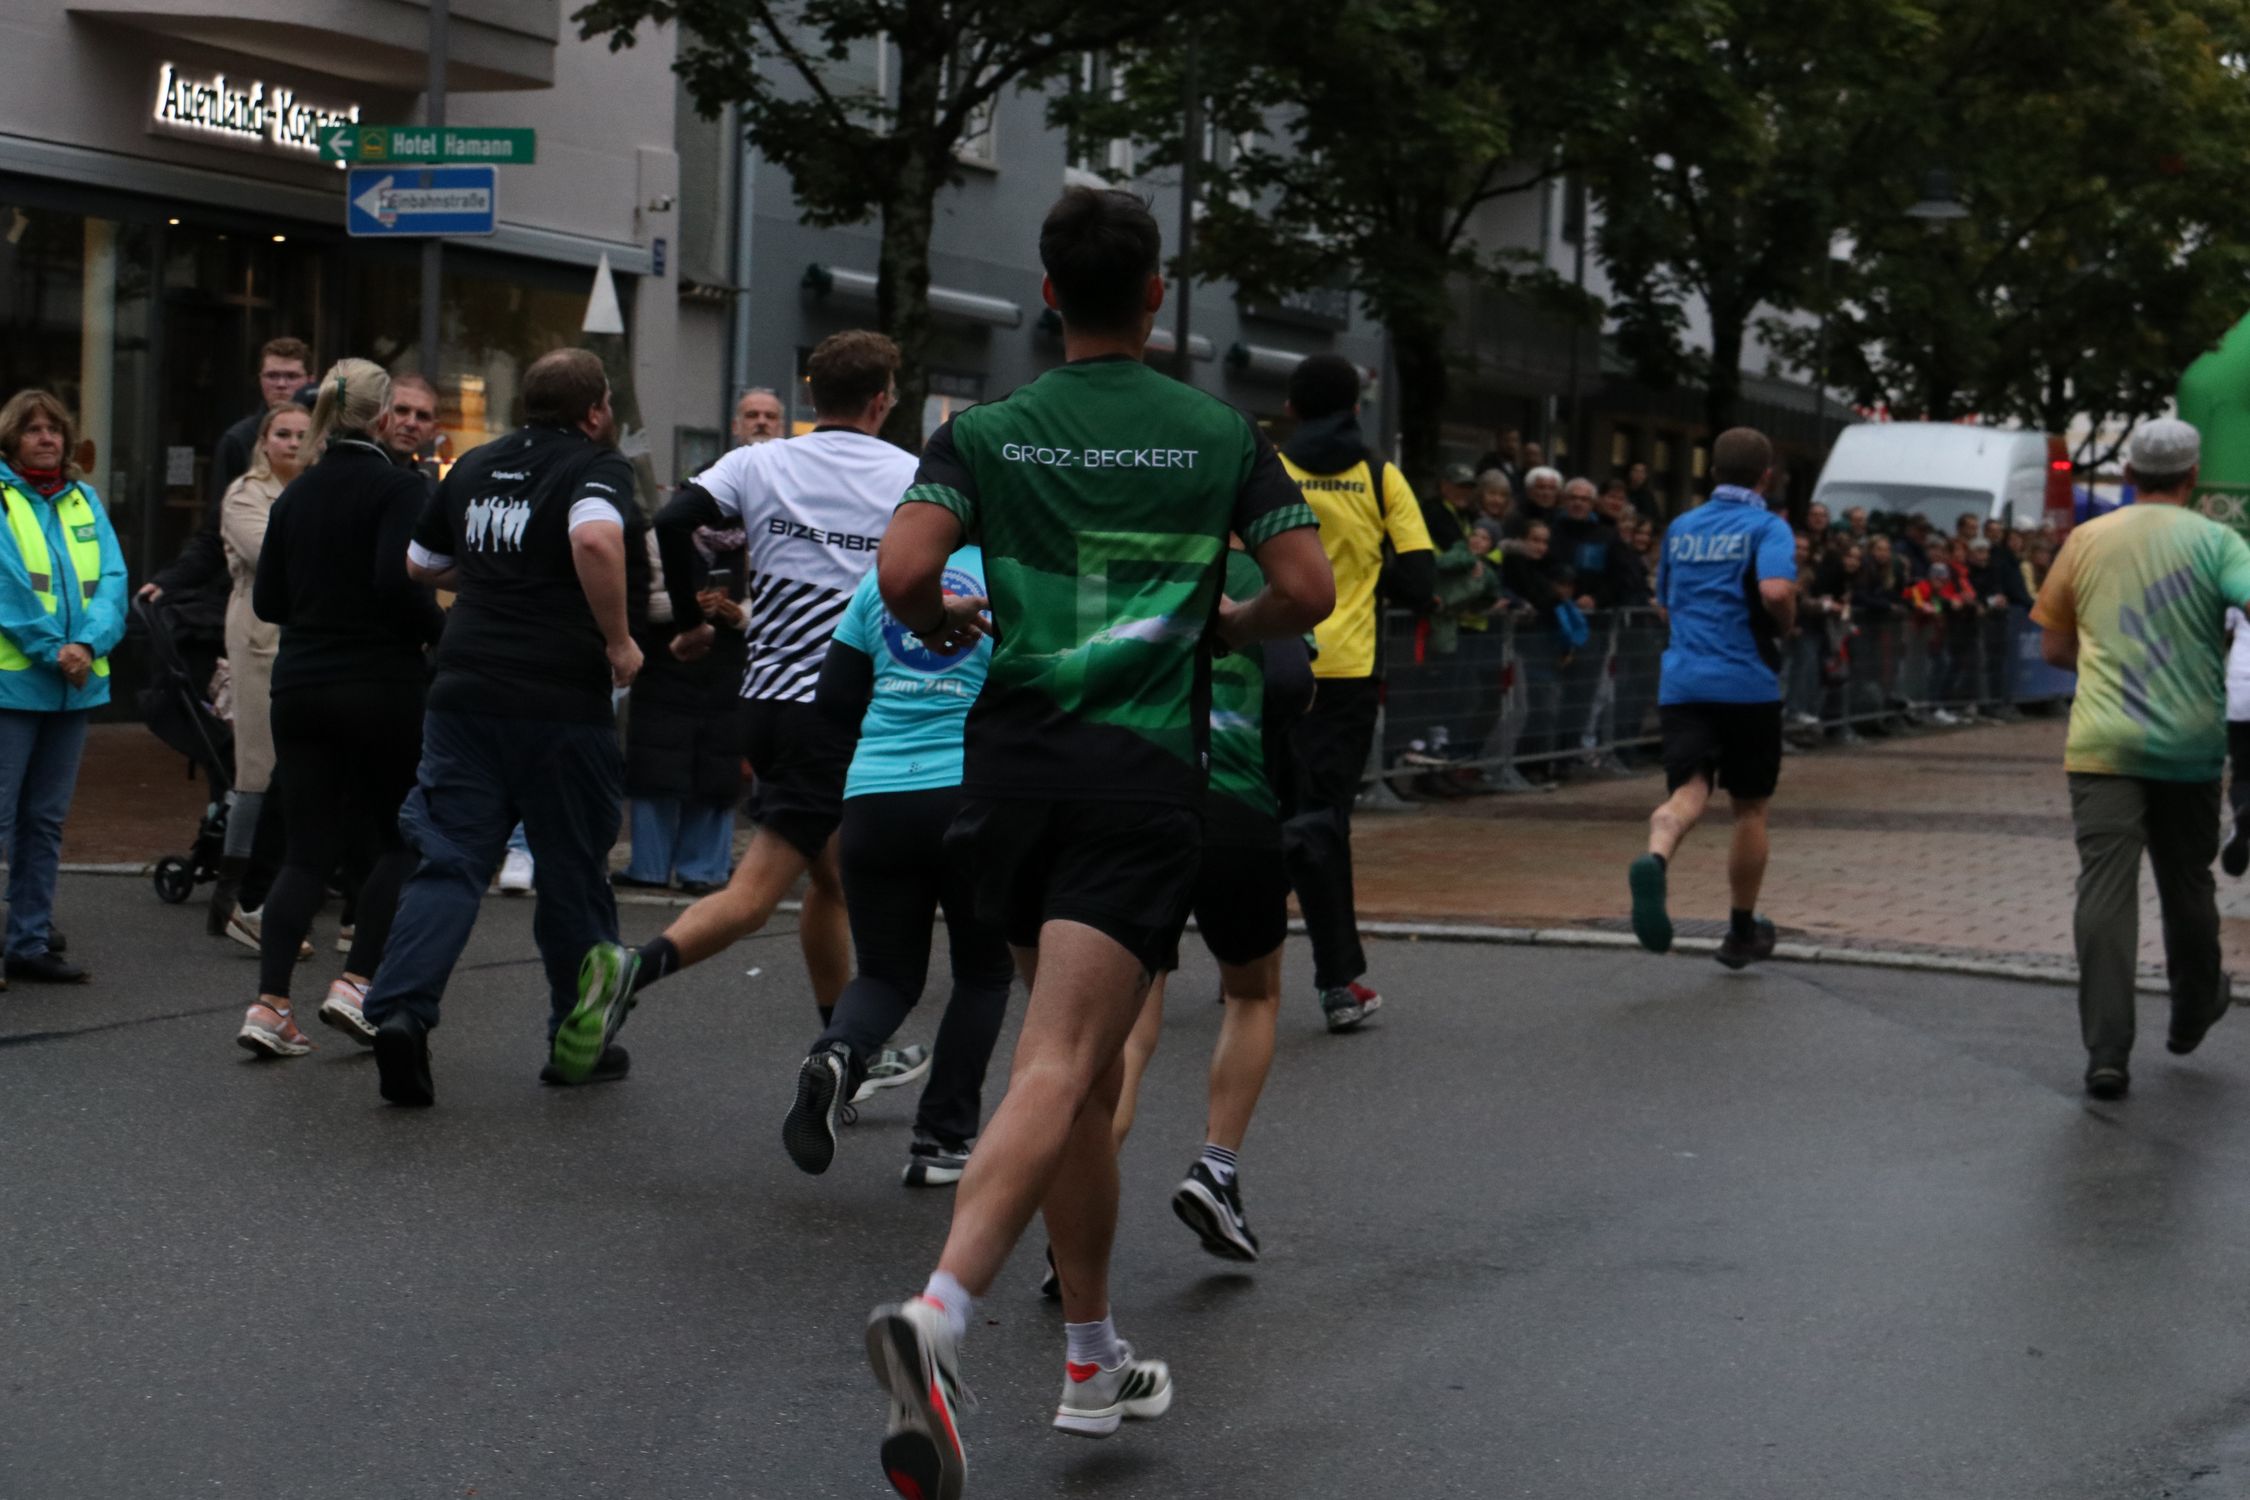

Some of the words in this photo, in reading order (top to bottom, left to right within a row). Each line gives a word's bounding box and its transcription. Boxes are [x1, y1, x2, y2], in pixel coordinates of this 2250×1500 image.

[154, 61, 360, 169] Auenland-Kon
[393, 133, 436, 155] Hotel
[444, 135, 513, 156] Hamann
[388, 193, 486, 209] Einbahnstraße
[1002, 443, 1199, 469] GROZ-BECKERT
[1298, 479, 1365, 494] HRING
[1669, 532, 1751, 562] POLIZEI
